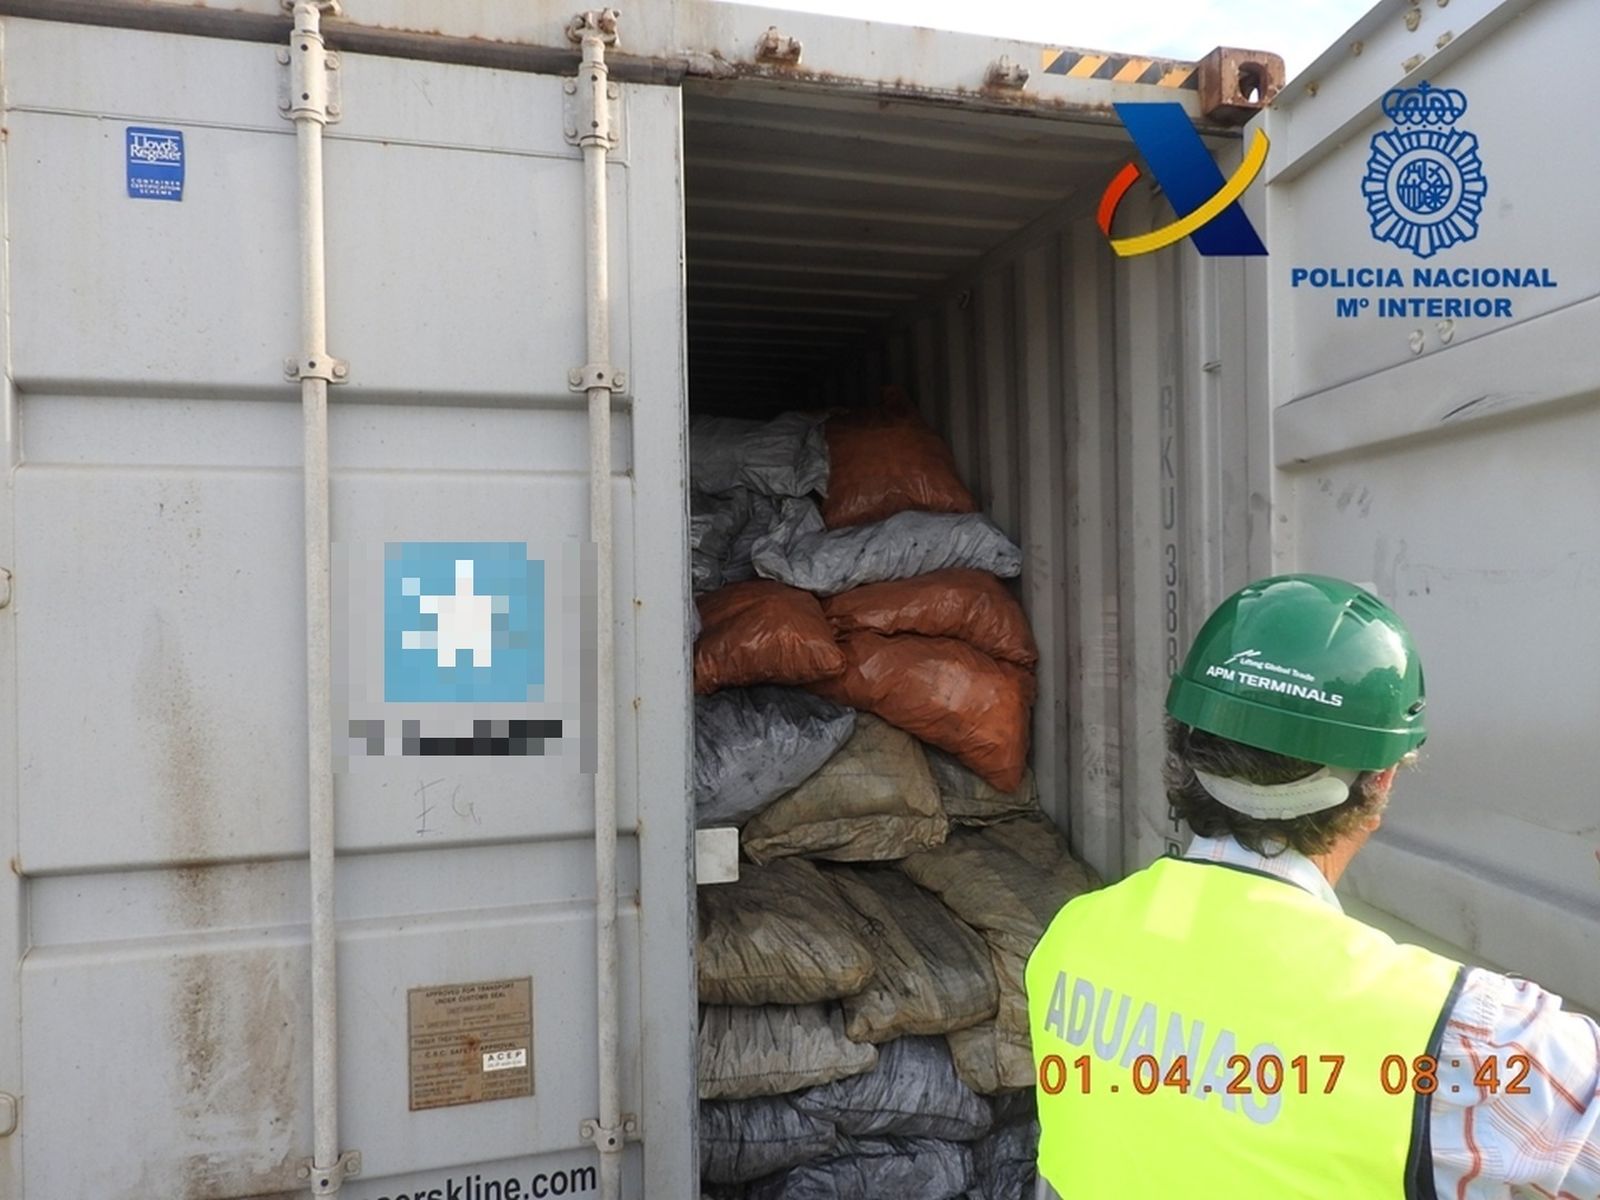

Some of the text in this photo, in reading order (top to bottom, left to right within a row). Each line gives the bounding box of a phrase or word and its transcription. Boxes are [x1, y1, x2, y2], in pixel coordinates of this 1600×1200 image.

[131, 144, 182, 162] Register
[133, 136, 179, 152] Lloyd's
[1264, 662, 1291, 675] Global
[1292, 668, 1316, 682] Trade
[1206, 665, 1344, 707] APM TERMINALS
[1044, 971, 1284, 1125] ADUANAS
